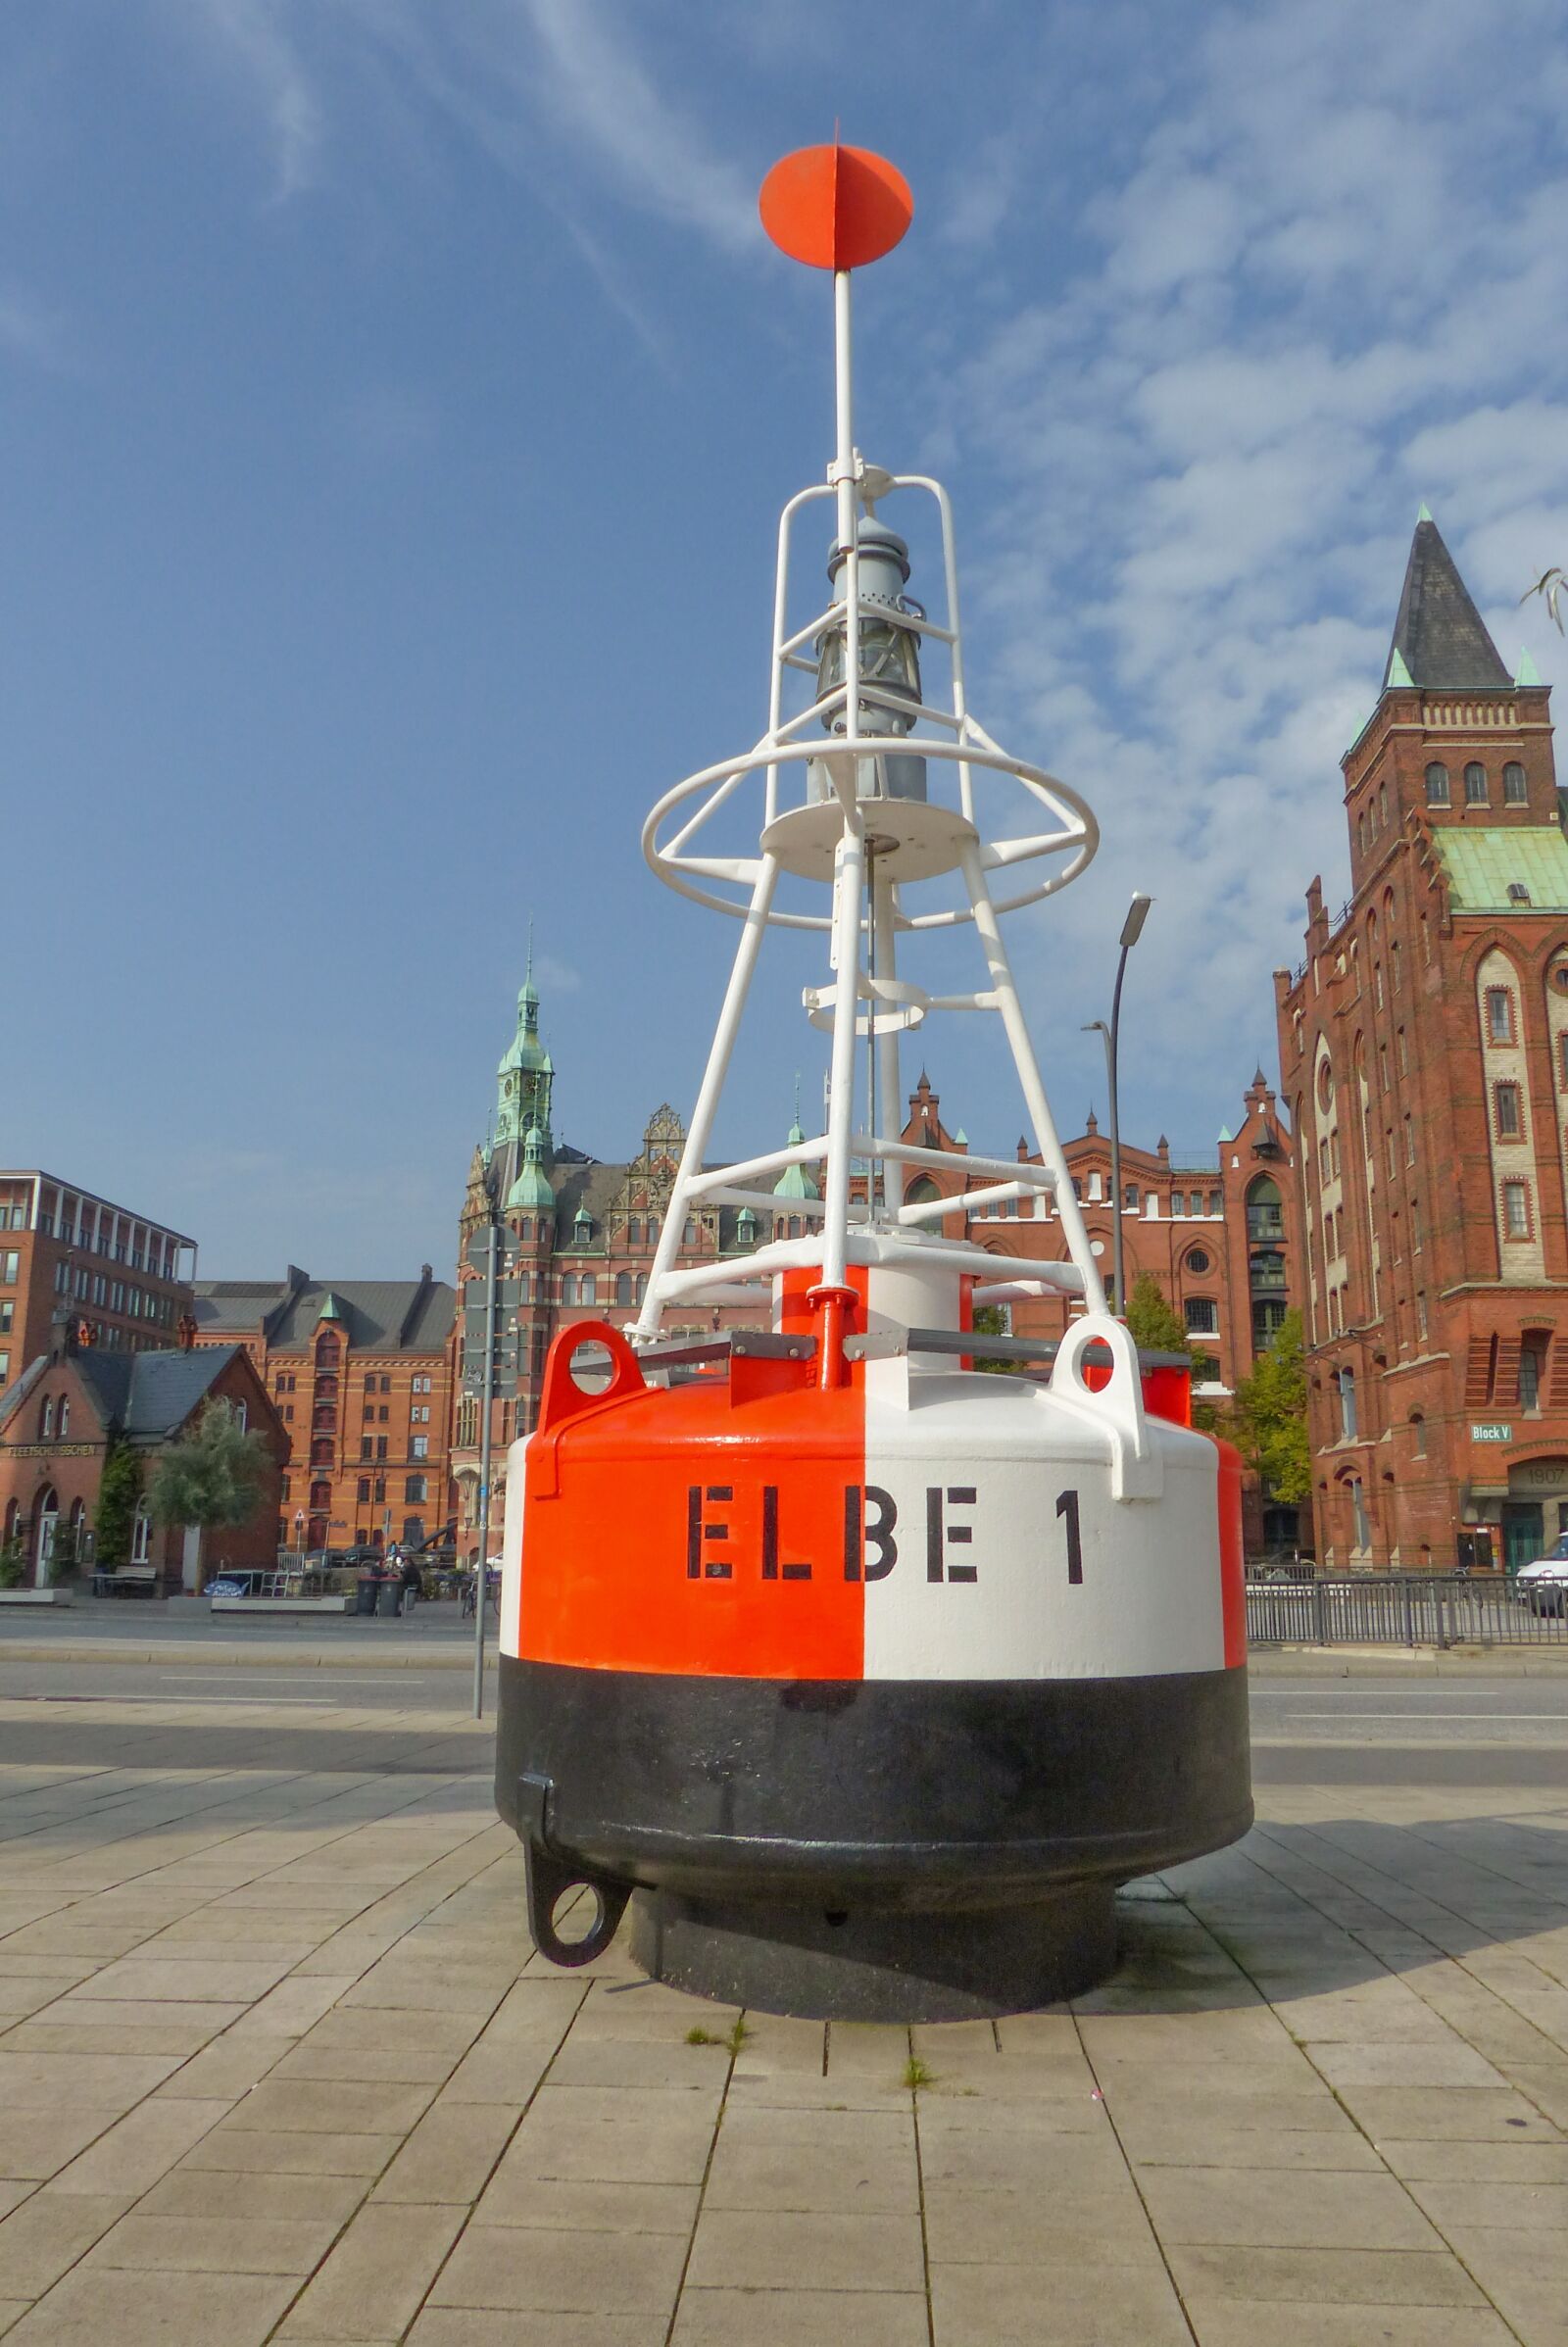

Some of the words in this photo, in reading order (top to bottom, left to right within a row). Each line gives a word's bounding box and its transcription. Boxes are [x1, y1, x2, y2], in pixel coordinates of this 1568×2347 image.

[1473, 1426, 1499, 1440] Block
[1501, 1426, 1508, 1440] V
[8, 1444, 95, 1457] FLEETSCHLSSCHEN
[1529, 1468, 1565, 1485] 1907
[687, 1485, 978, 1584] ELBE
[1055, 1490, 1084, 1585] 1
